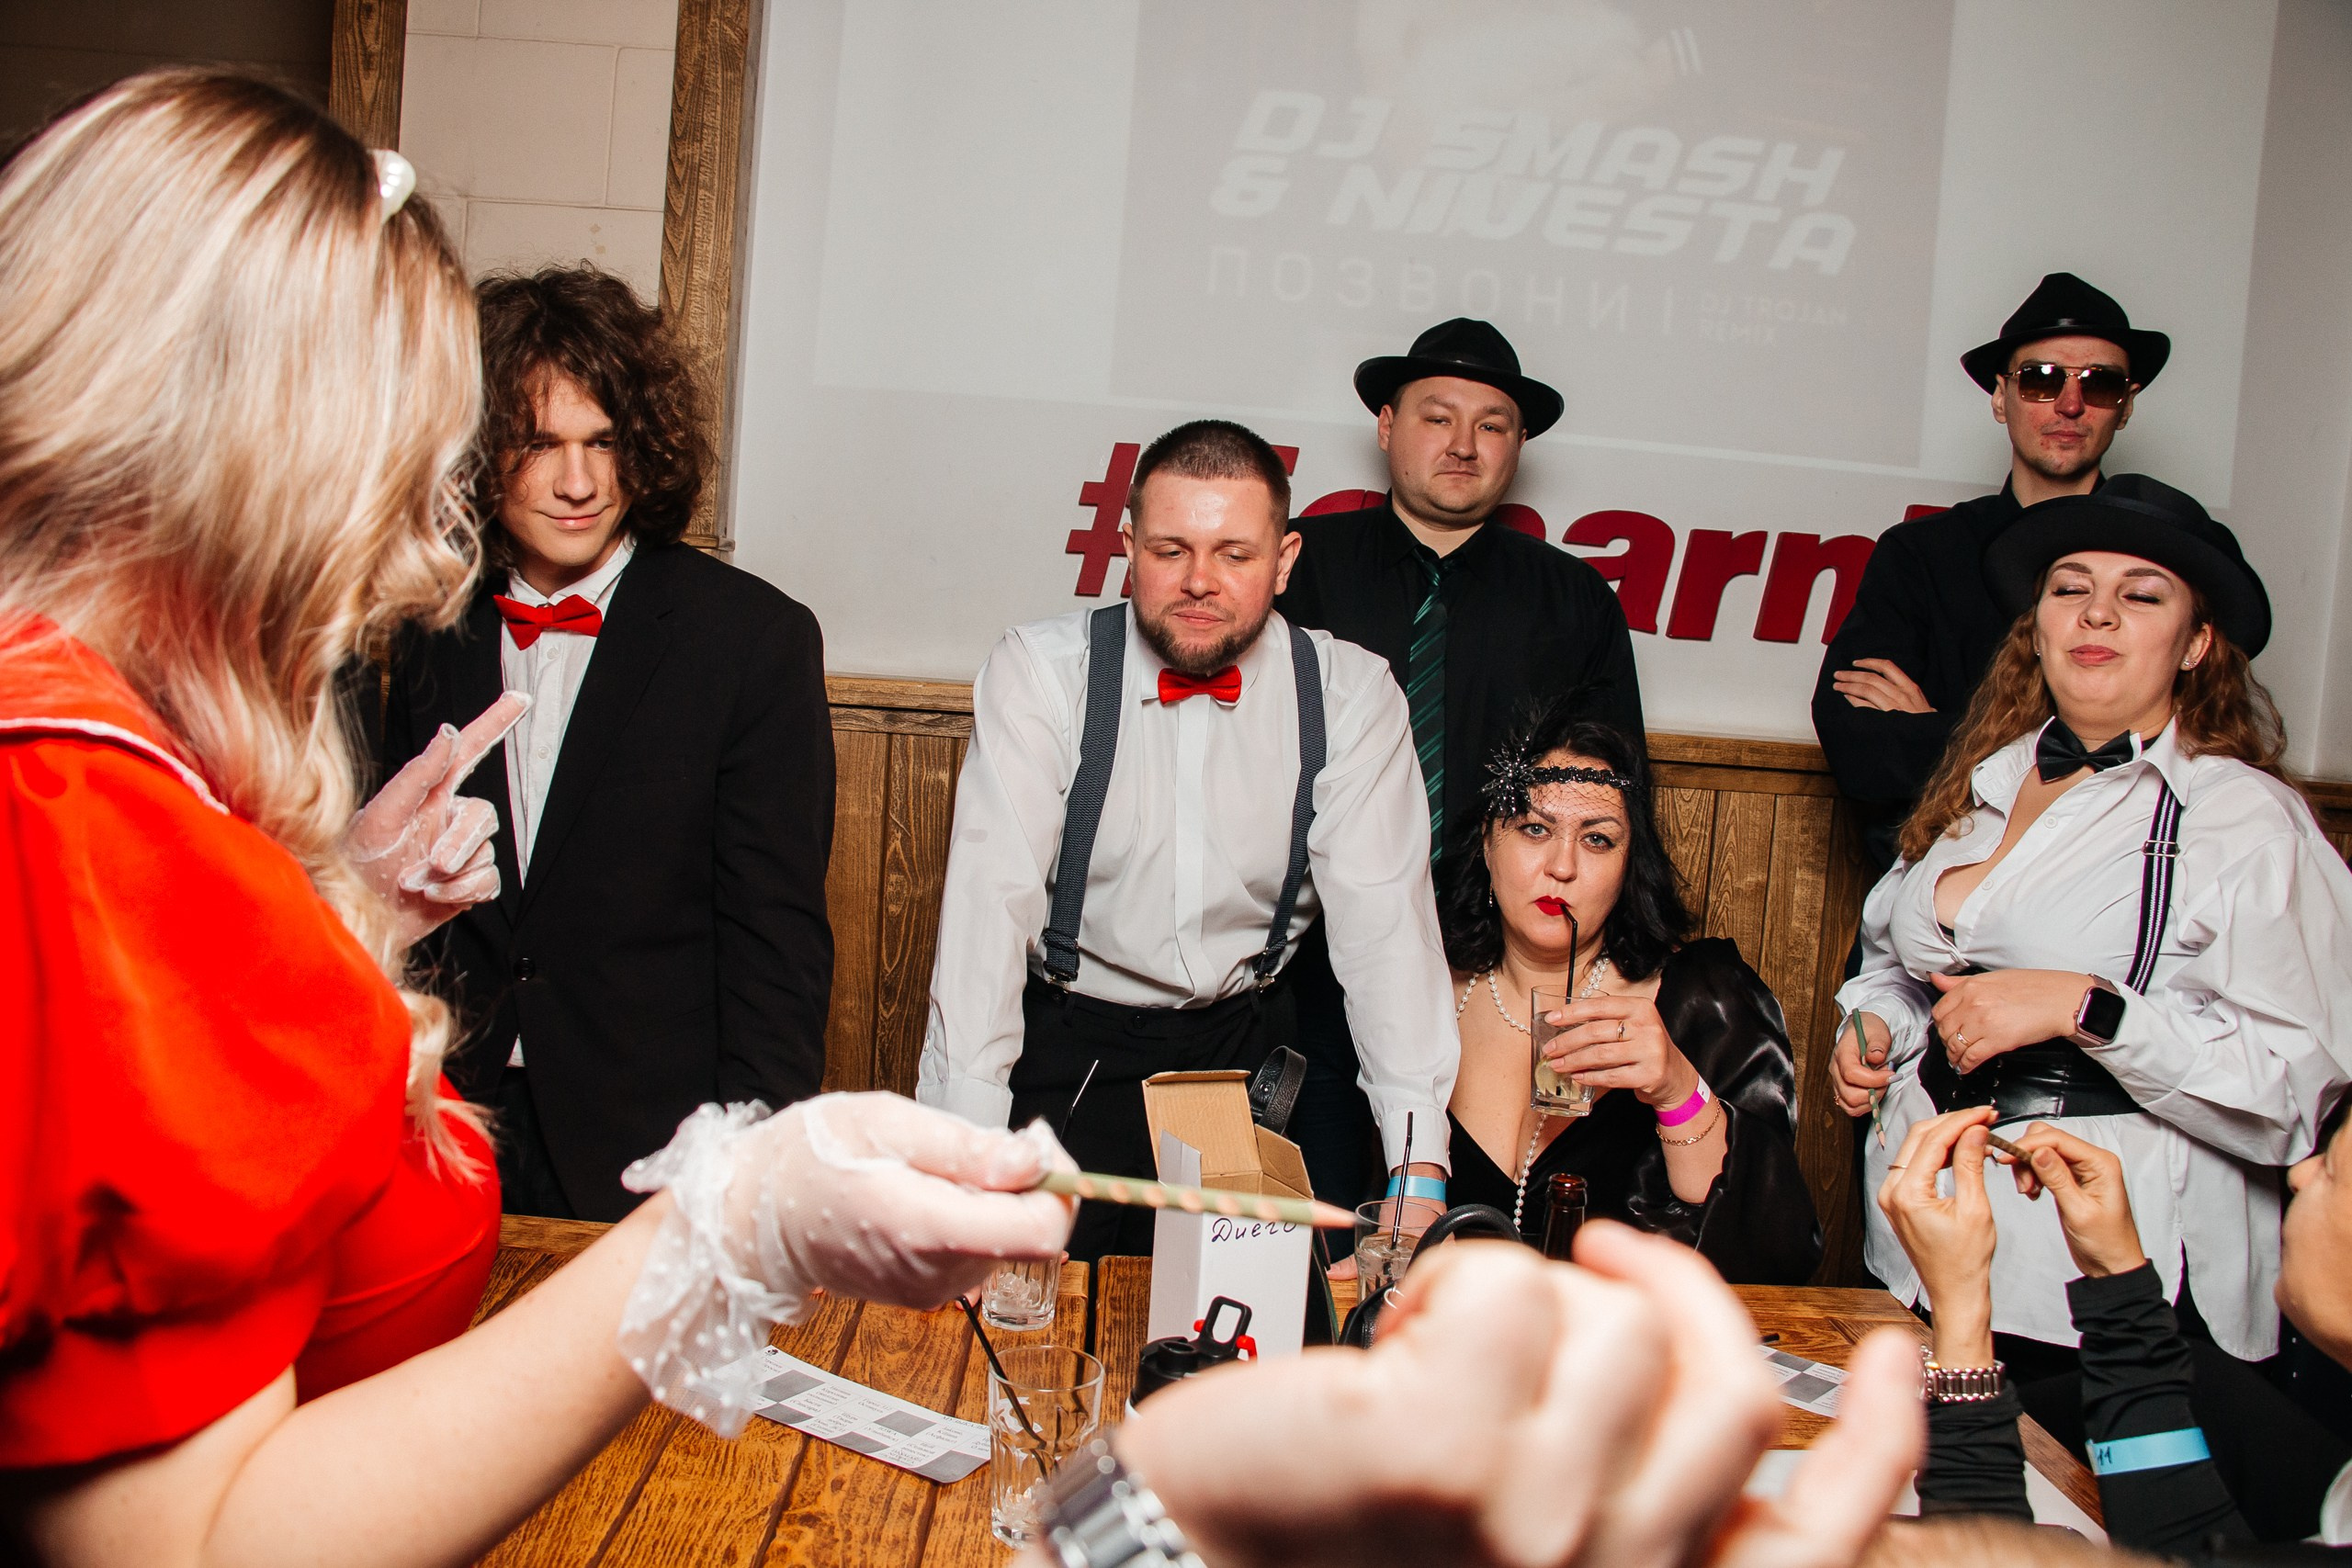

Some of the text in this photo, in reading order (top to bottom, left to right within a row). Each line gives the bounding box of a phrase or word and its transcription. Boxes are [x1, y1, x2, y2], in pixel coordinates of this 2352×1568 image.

[1234, 90, 1847, 207] DJ SMASH
[1208, 154, 1857, 276] & NIVESTA
[1204, 245, 1631, 335] ПОЗВОНИ
